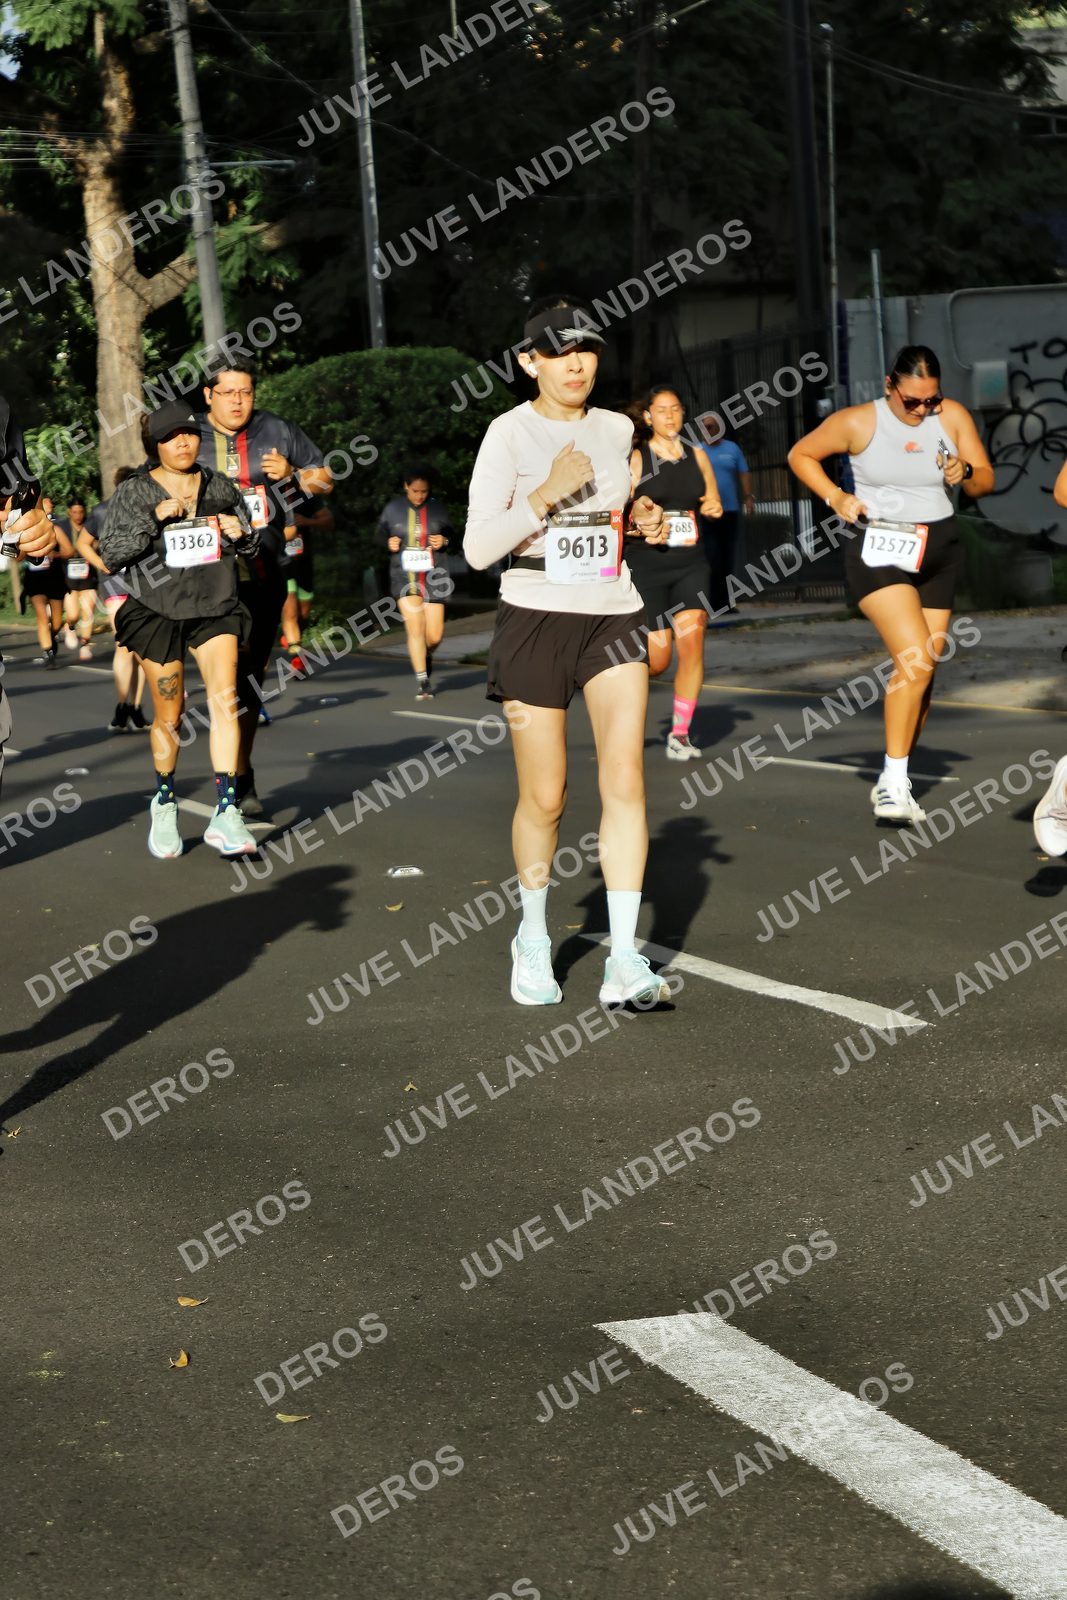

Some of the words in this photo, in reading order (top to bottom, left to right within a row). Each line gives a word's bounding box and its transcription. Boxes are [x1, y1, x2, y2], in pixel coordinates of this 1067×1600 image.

[169, 533, 214, 551] 13362
[557, 534, 609, 560] 9613
[869, 535, 917, 556] 12577
